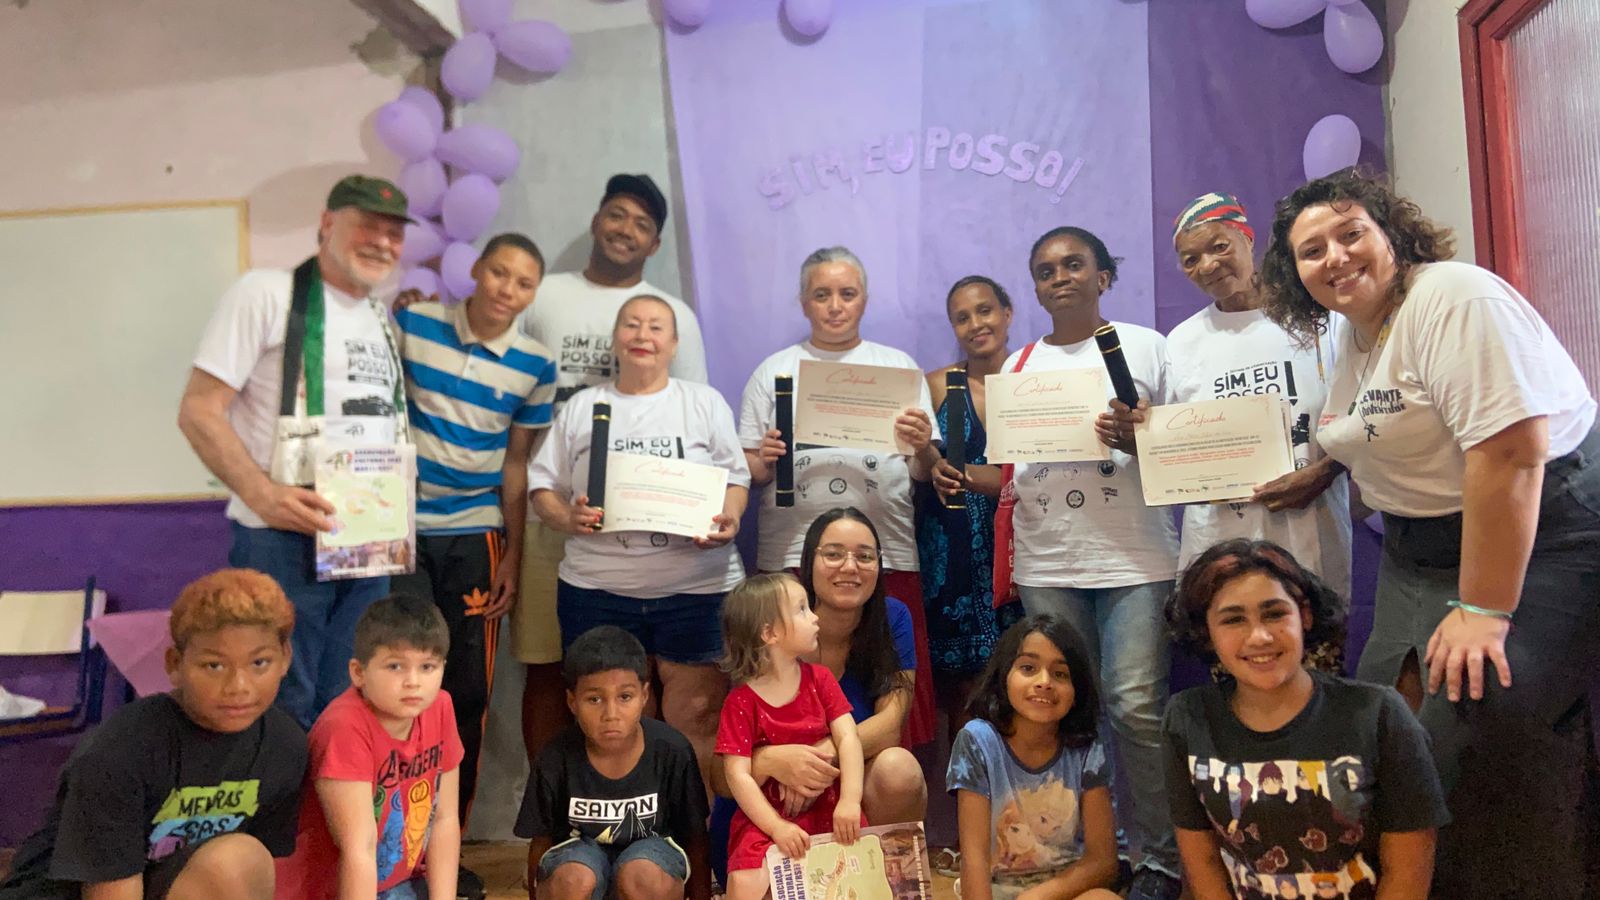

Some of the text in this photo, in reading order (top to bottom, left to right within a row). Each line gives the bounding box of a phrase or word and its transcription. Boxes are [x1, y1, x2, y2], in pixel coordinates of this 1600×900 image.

[757, 126, 1085, 211] SIM, EU POSSO!
[561, 351, 612, 366] POSSO
[1253, 365, 1279, 384] EU
